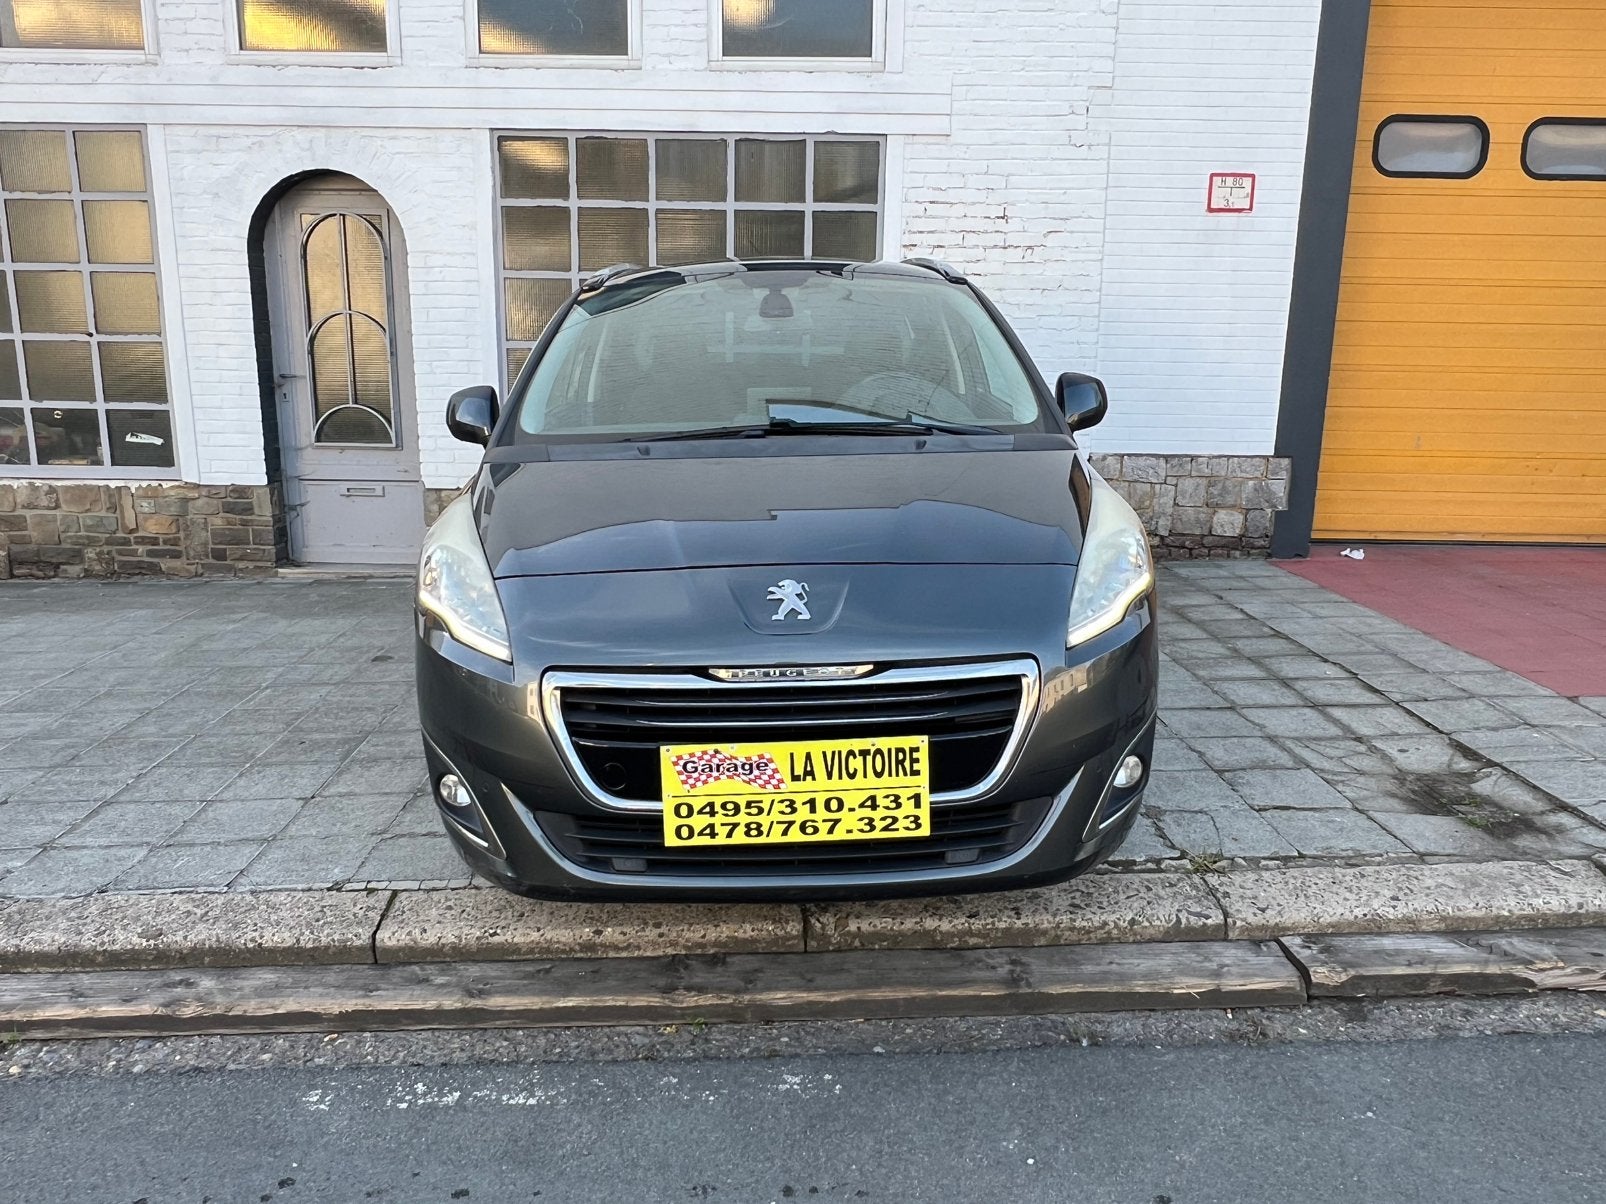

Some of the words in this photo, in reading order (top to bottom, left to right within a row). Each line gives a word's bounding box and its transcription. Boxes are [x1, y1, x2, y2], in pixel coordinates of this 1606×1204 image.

[1220, 177, 1227, 186] H
[1232, 177, 1244, 186] 80
[681, 759, 770, 777] Garage
[789, 751, 817, 783] LA
[822, 746, 922, 781] VICTOIRE
[673, 792, 923, 819] 0495/310.431
[674, 814, 923, 841] 0478/767.323
